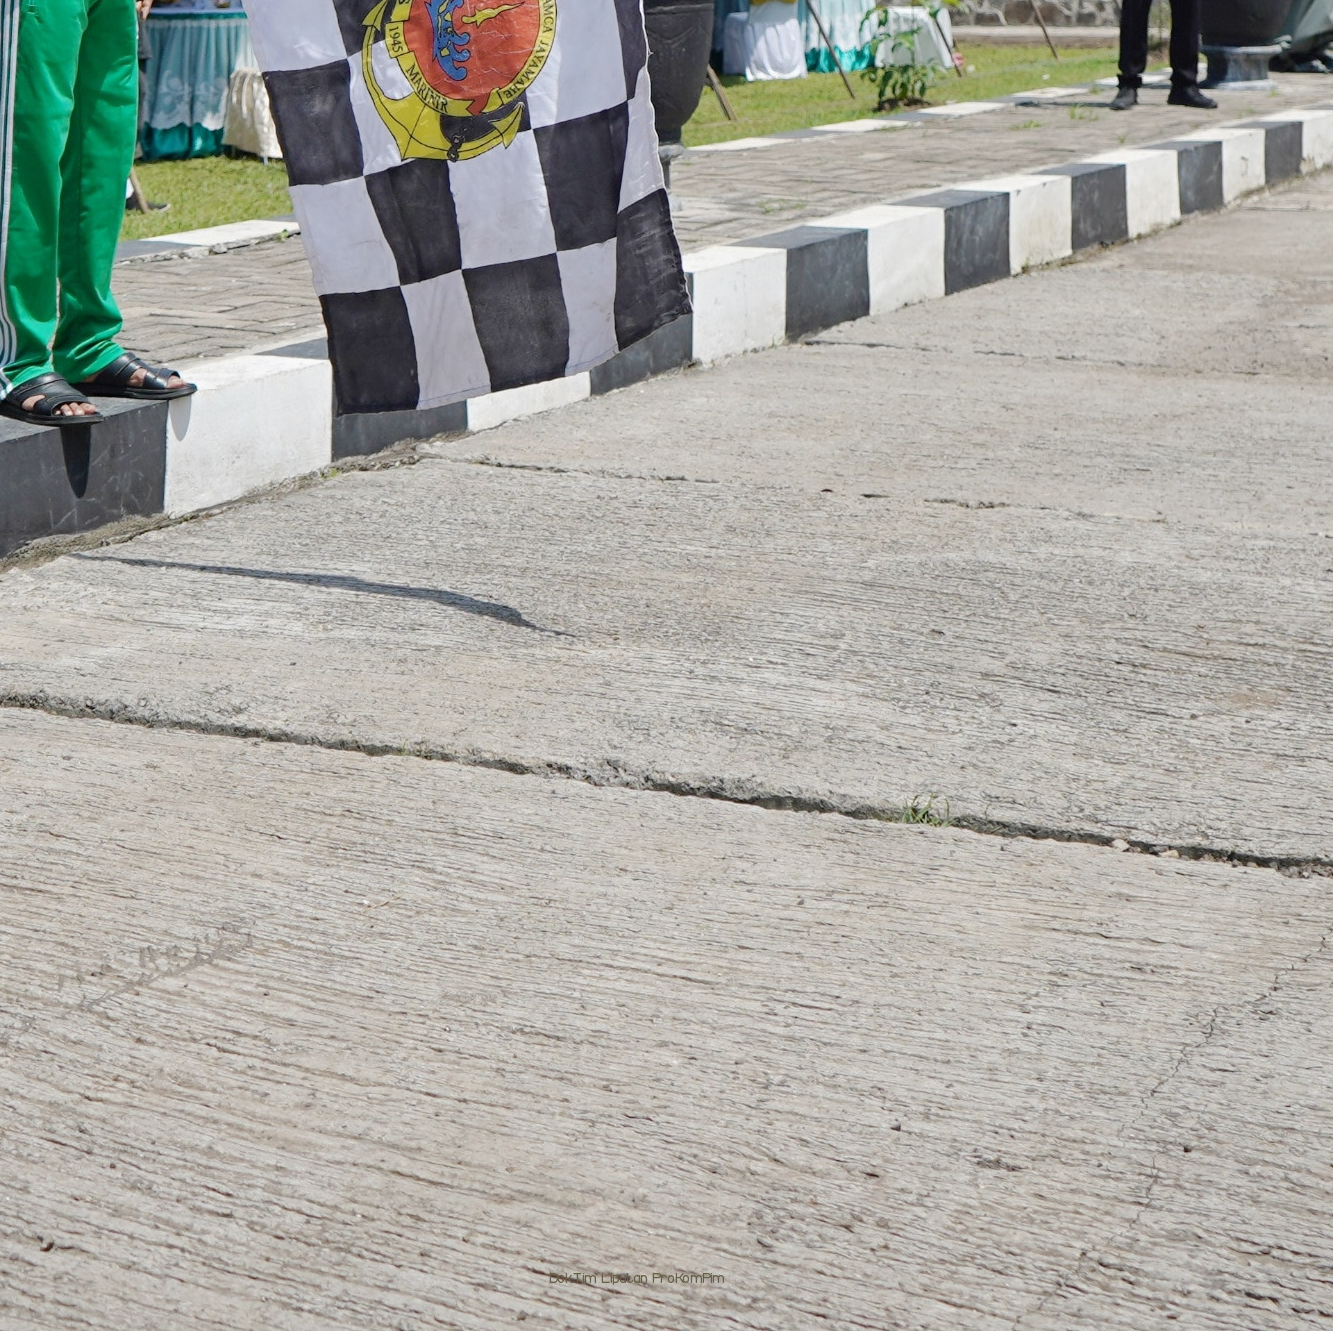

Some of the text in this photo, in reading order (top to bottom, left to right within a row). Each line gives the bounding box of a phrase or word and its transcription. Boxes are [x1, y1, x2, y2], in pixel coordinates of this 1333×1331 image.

[389, 26, 404, 53] 1945
[406, 62, 448, 113] MARINIR
[504, 39, 550, 99] JAYAMAHE
